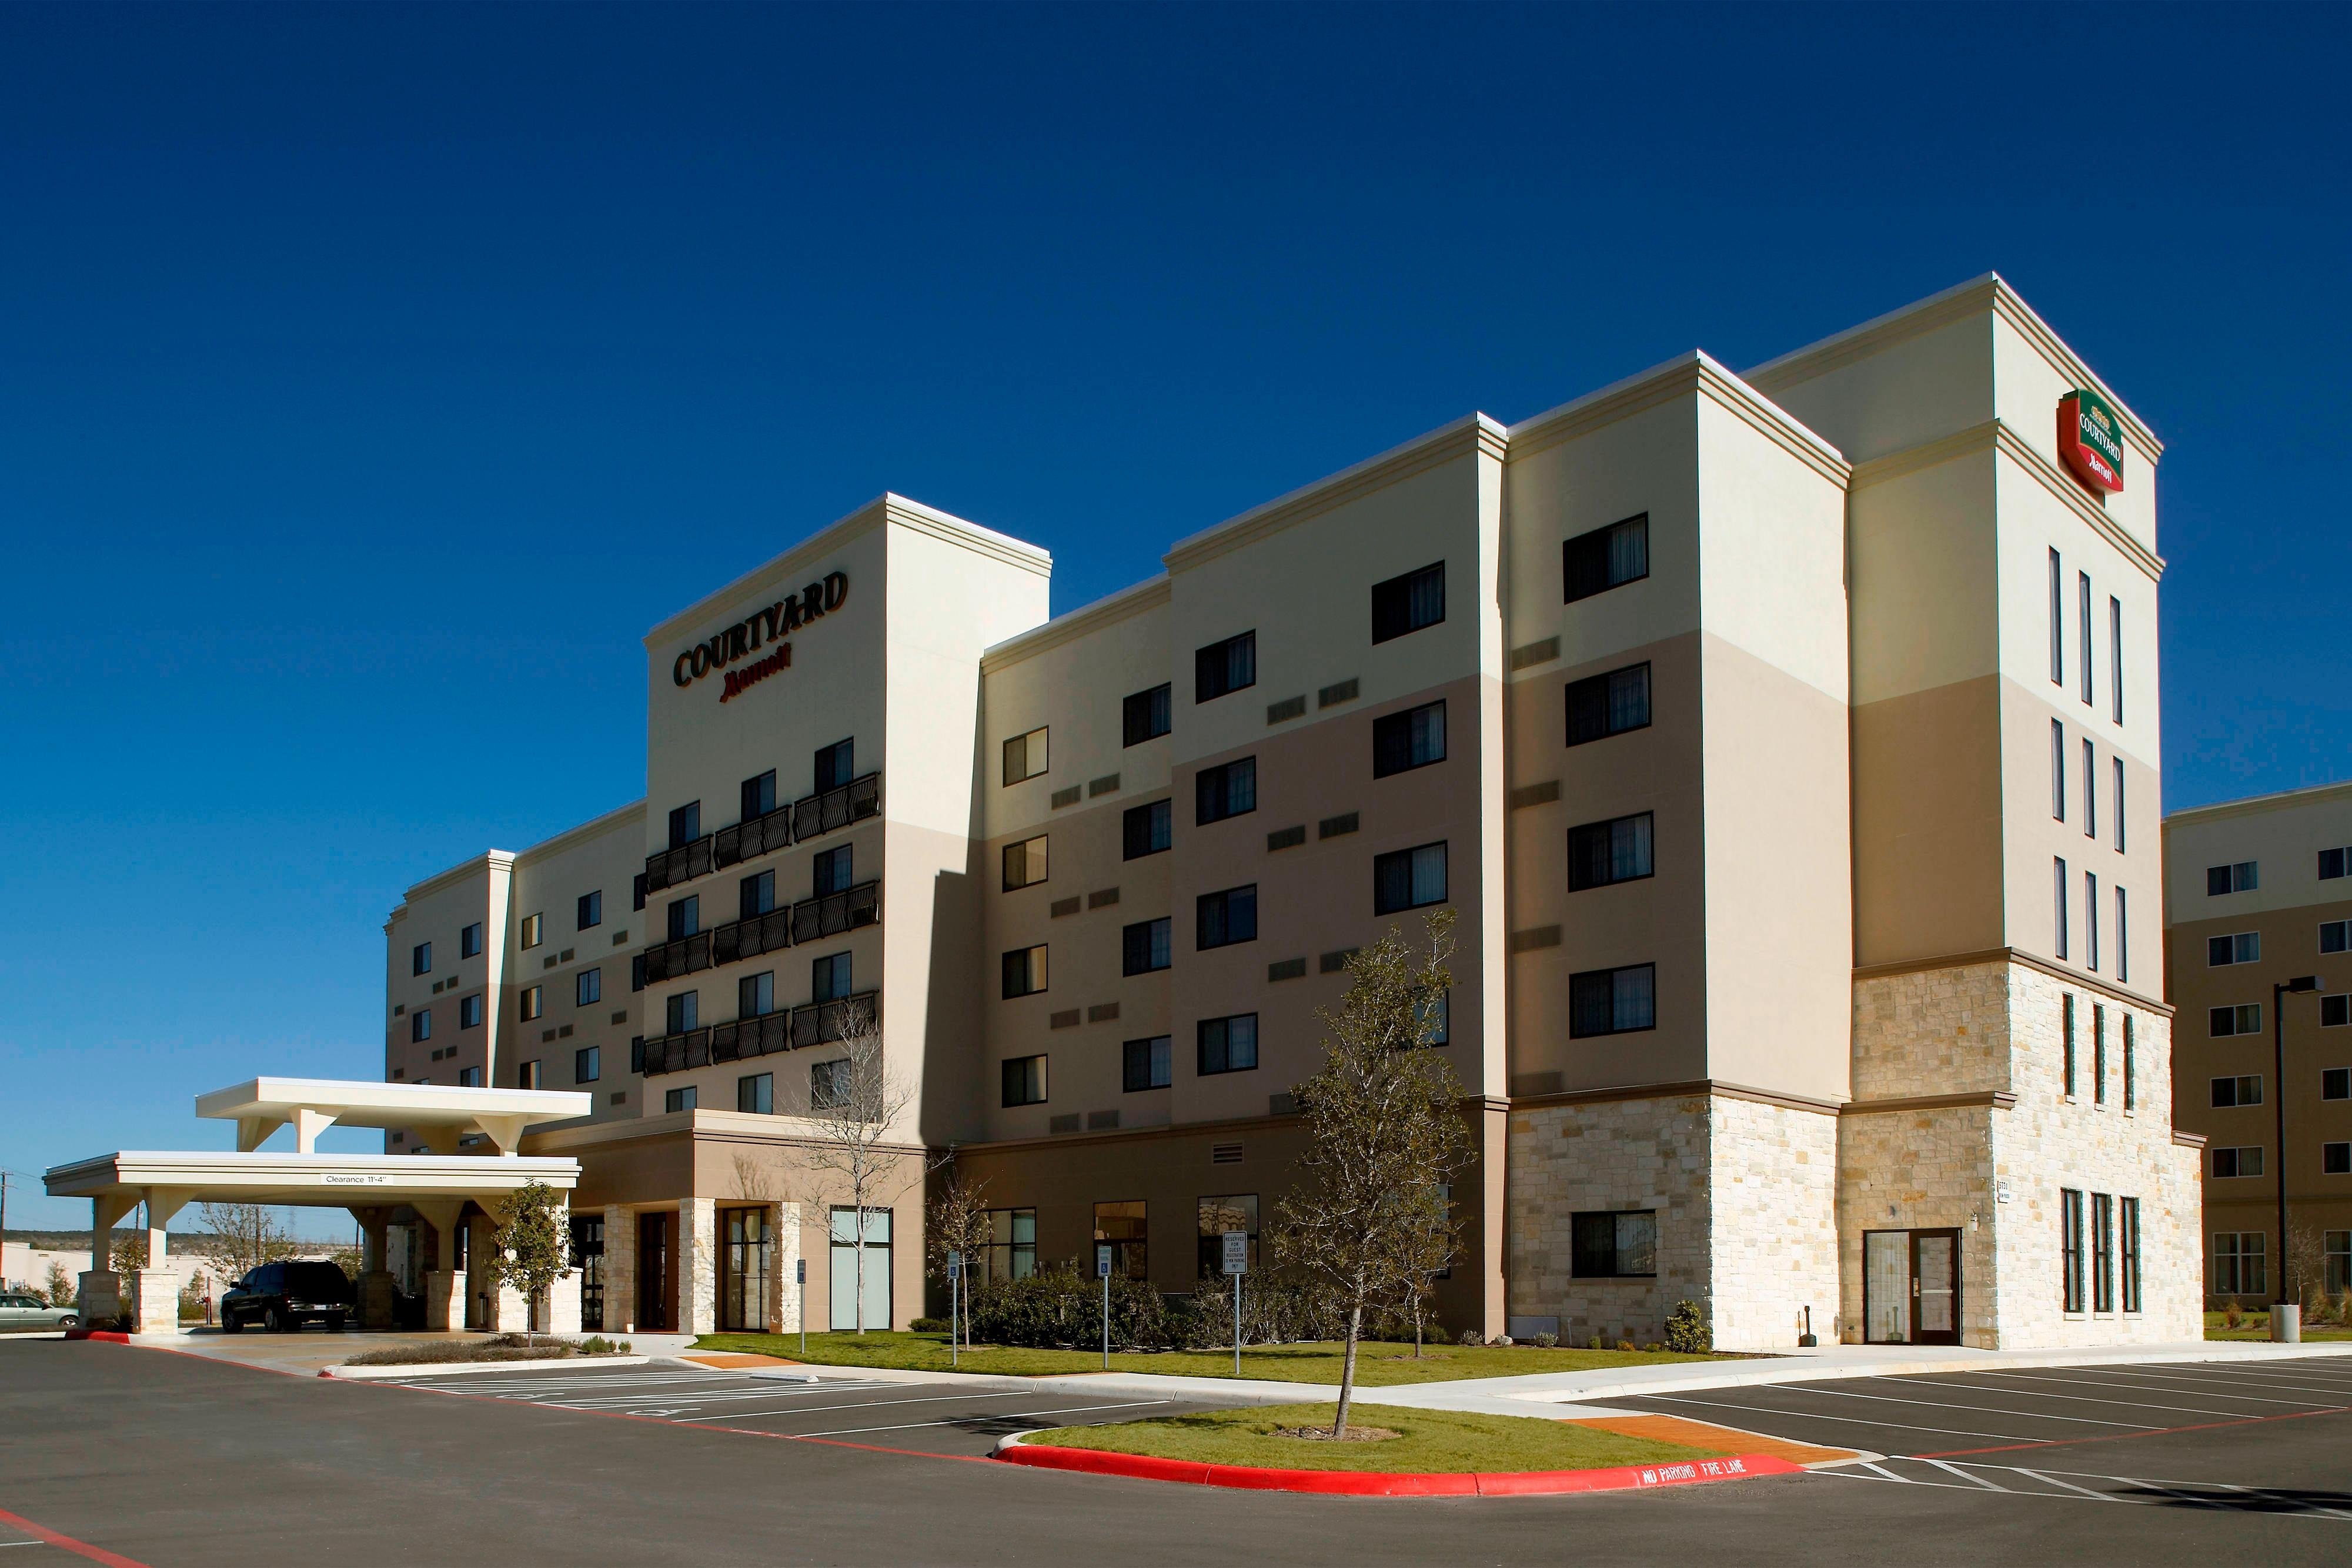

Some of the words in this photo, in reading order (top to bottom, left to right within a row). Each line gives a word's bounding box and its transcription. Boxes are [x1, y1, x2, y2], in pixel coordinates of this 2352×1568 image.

[2079, 413, 2120, 462] COURTYARD
[2089, 453, 2112, 483] Marriott
[673, 571, 848, 687] COURTYARD
[719, 641, 791, 703] Marriott
[1642, 1469, 1657, 1484] NO
[1658, 1465, 1696, 1482] PARKING
[1700, 1461, 1723, 1476] FIRE
[1722, 1459, 1747, 1474] LANE
